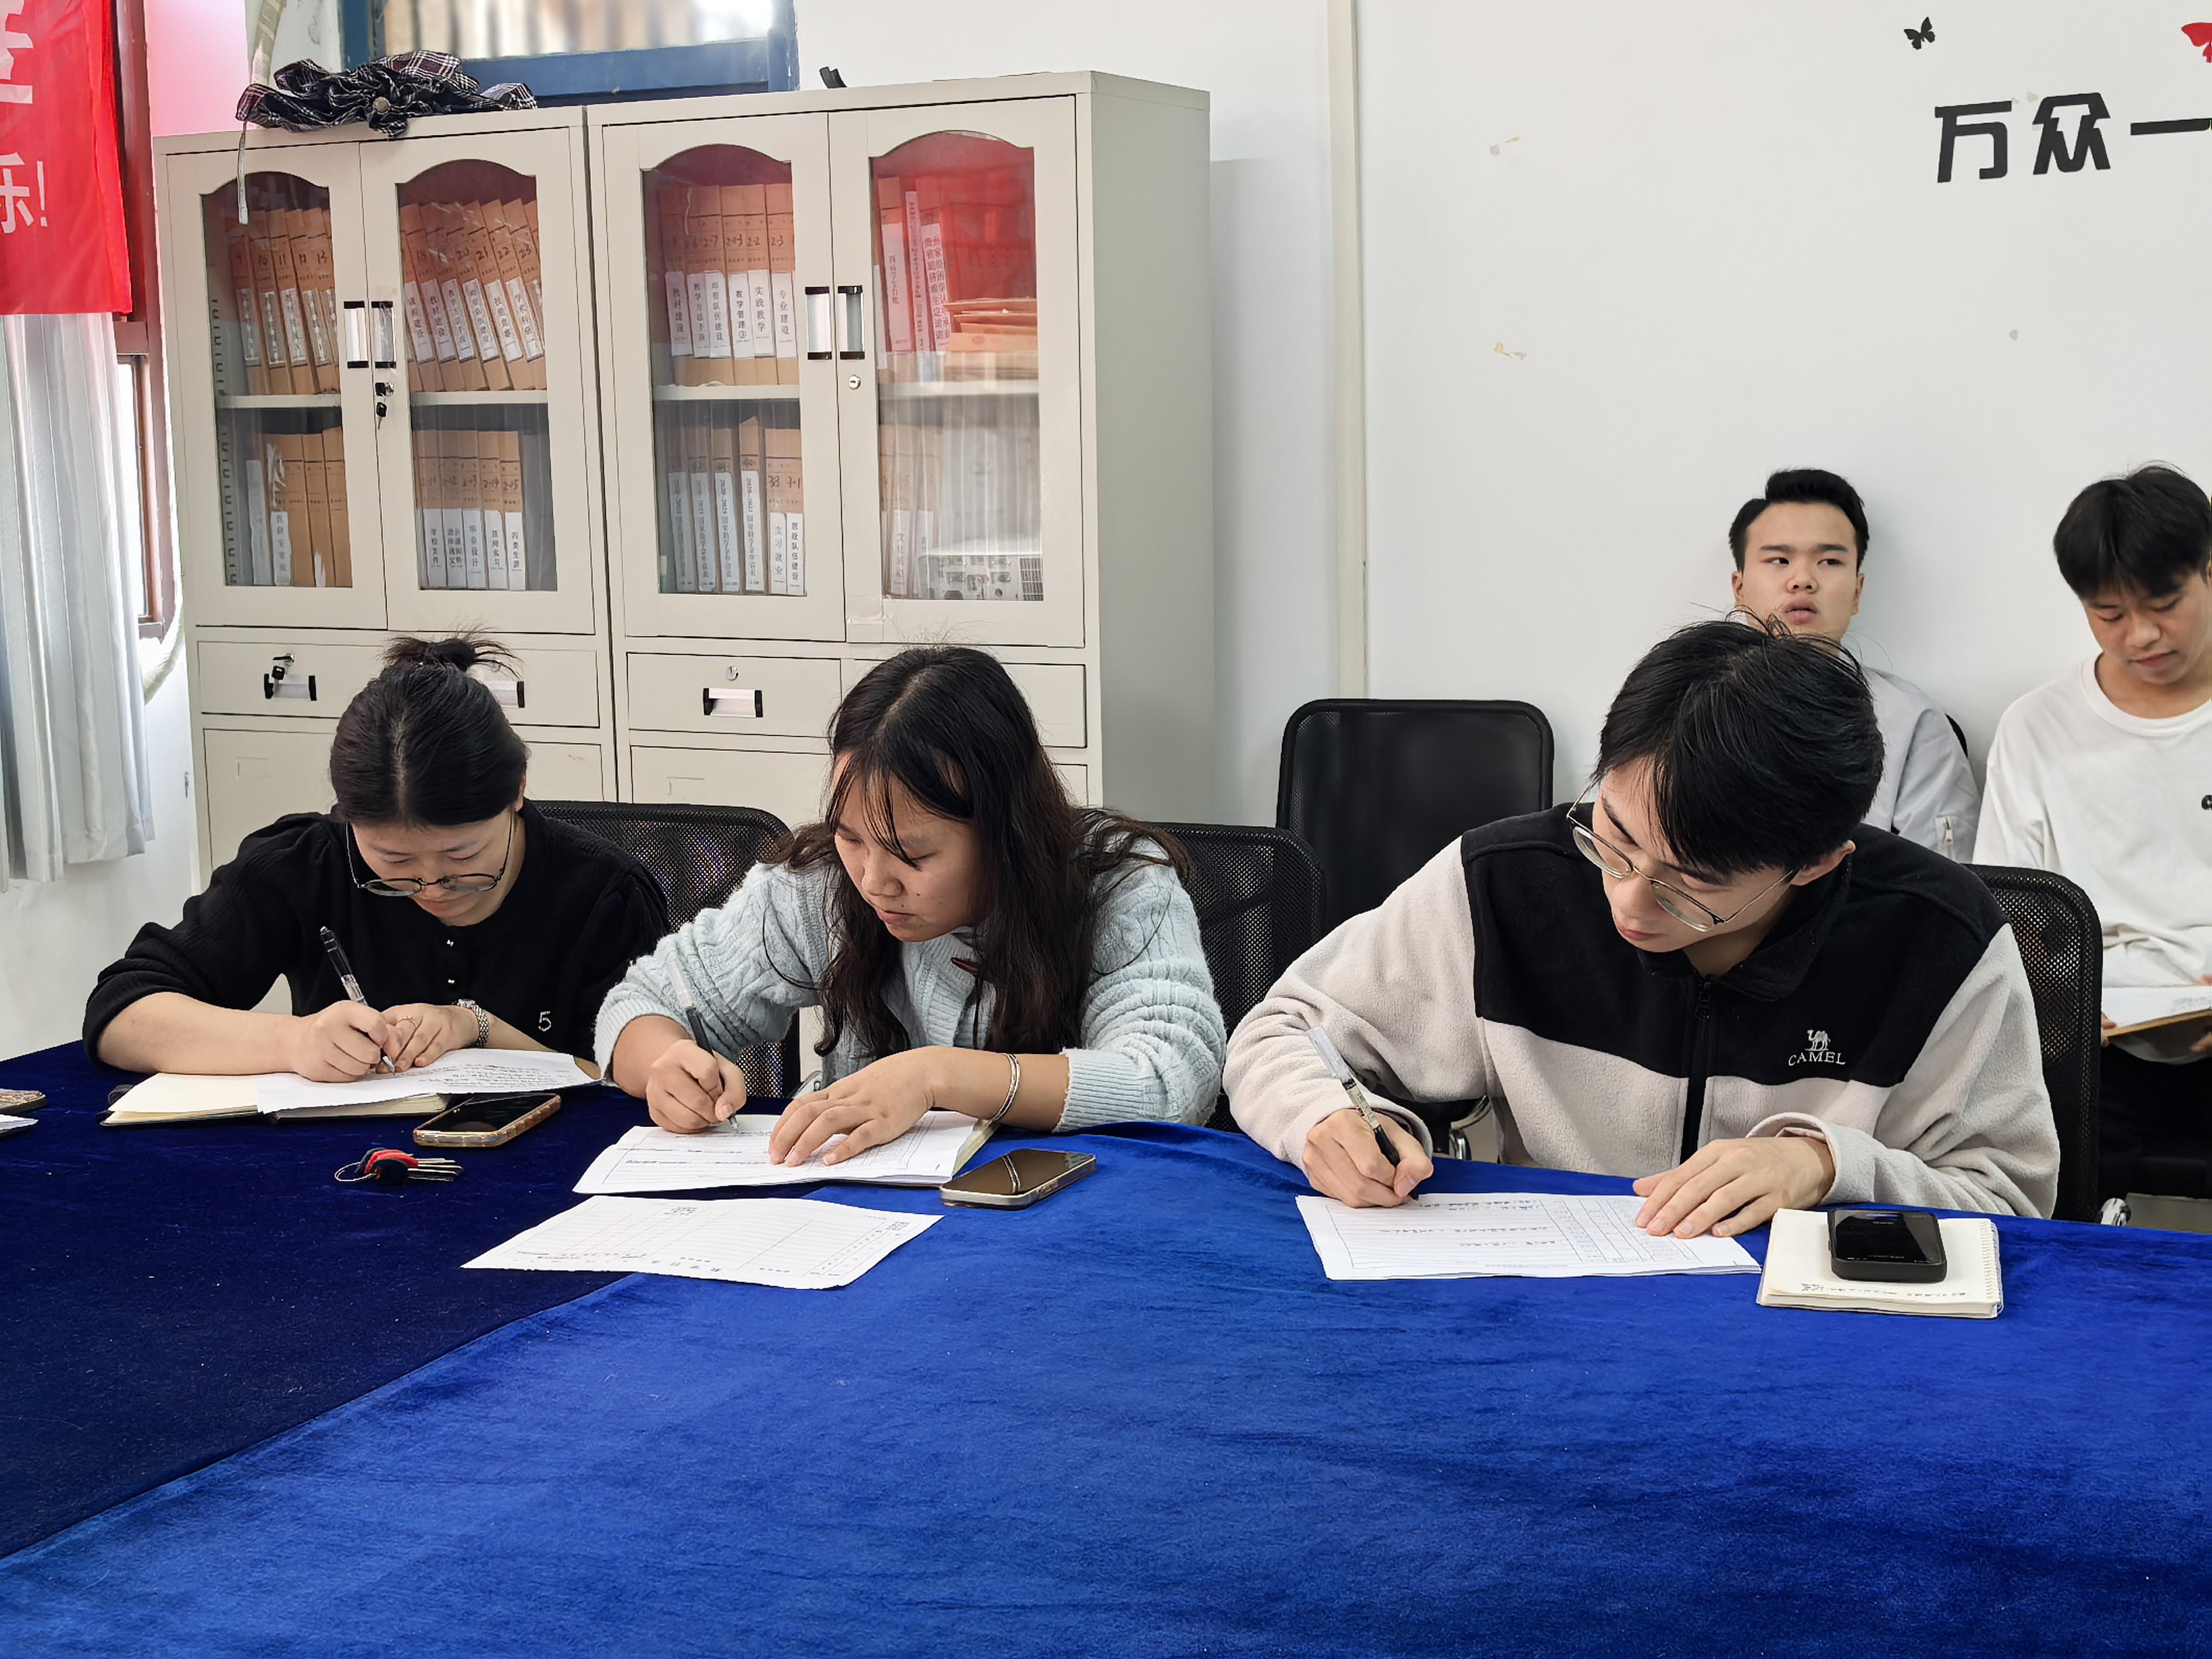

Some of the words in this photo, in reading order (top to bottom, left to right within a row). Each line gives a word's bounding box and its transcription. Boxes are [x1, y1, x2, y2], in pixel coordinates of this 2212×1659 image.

[1934, 92, 2212, 183] 万众一
[754, 286, 766, 333] 实践教学
[538, 1011, 551, 1031] 5
[1788, 1051, 1846, 1066] CAMEL
